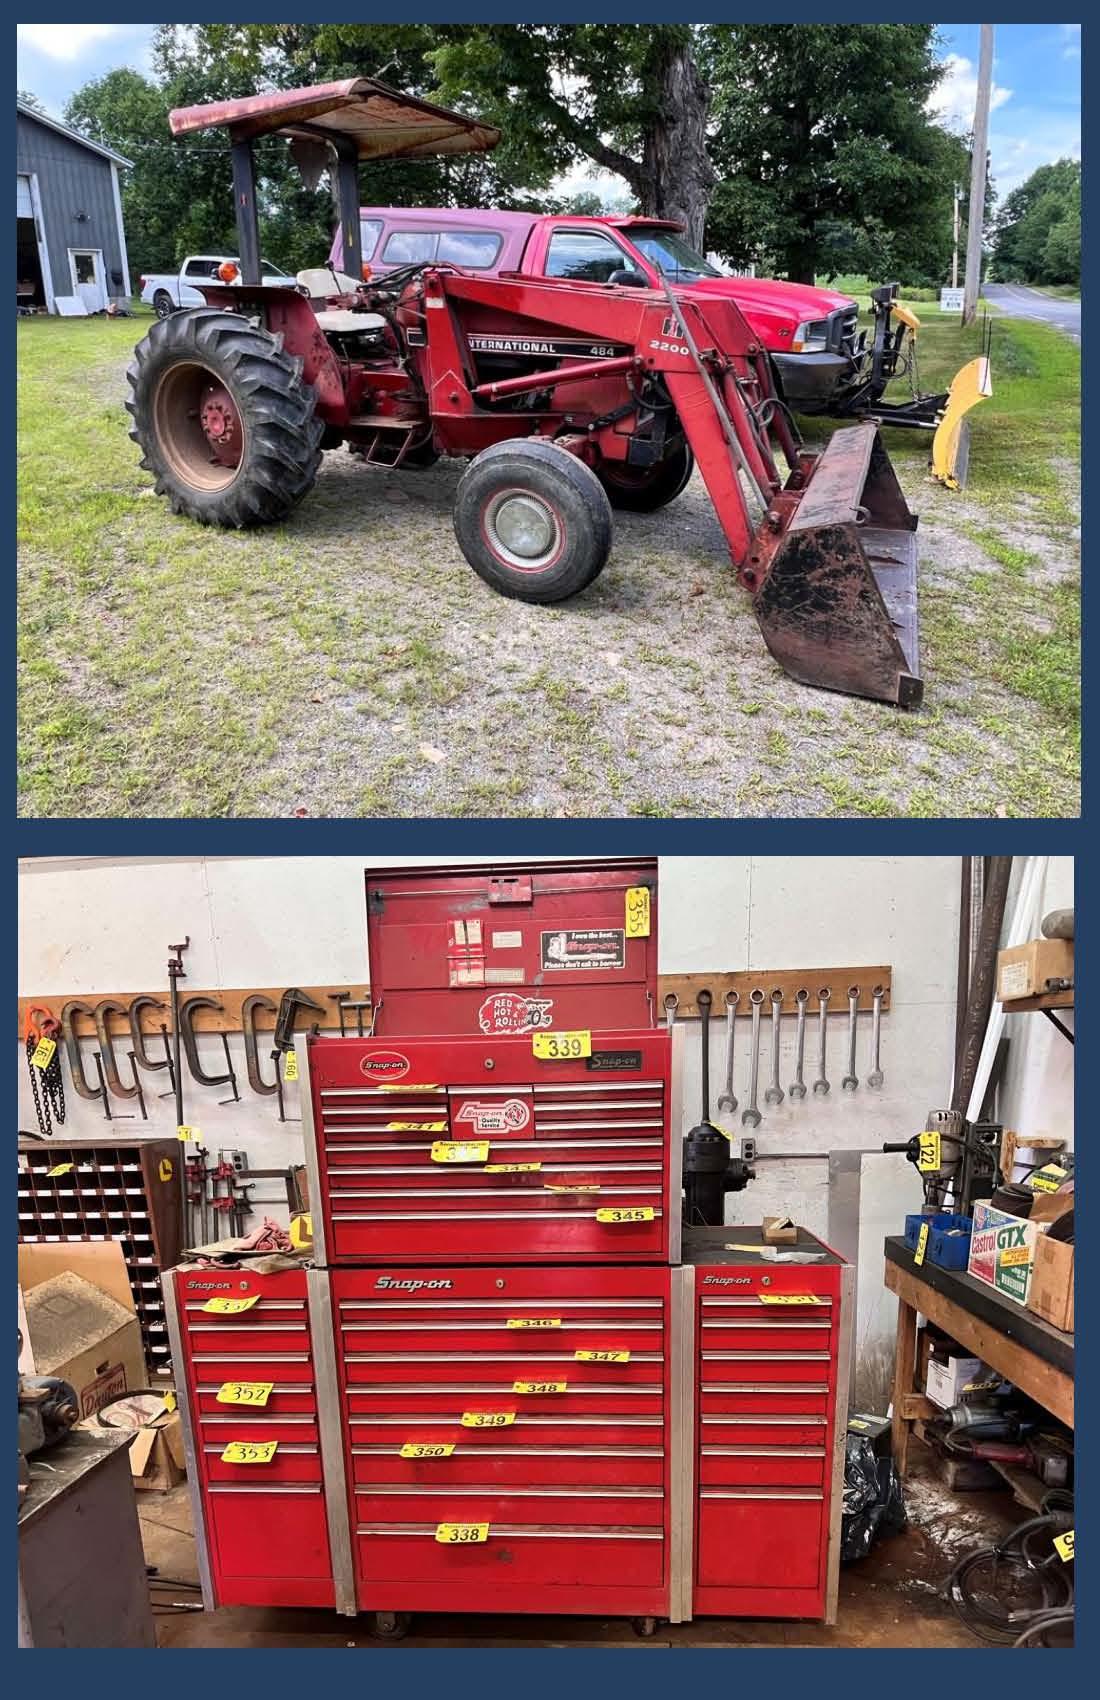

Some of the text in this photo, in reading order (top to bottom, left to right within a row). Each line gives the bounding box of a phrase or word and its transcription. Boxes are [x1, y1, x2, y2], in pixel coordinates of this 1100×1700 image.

[468, 339, 615, 356] NTERNATIONAL 484
[650, 340, 689, 355] 2200
[628, 898, 644, 933] 355
[544, 961, 565, 969] Please
[494, 999, 513, 1008] RED
[494, 1008, 511, 1018] HOT
[548, 1039, 582, 1057] 339
[365, 1061, 404, 1070] Snap-on
[592, 1053, 637, 1068] Snap-on
[920, 1142, 935, 1165] 122
[612, 1211, 644, 1221] 345
[972, 1232, 997, 1255] Castrol
[997, 1224, 1028, 1250] GTX
[186, 1280, 231, 1290] Snap-on
[374, 1276, 452, 1292] Snap-on
[703, 1276, 752, 1286] Snap-on
[588, 1352, 620, 1361] 347
[234, 1386, 266, 1401] 352
[527, 1384, 557, 1392] 348
[475, 1415, 506, 1426] 349
[240, 1447, 270, 1460] 353
[413, 1447, 445, 1457] 350
[449, 1528, 480, 1542] 338
